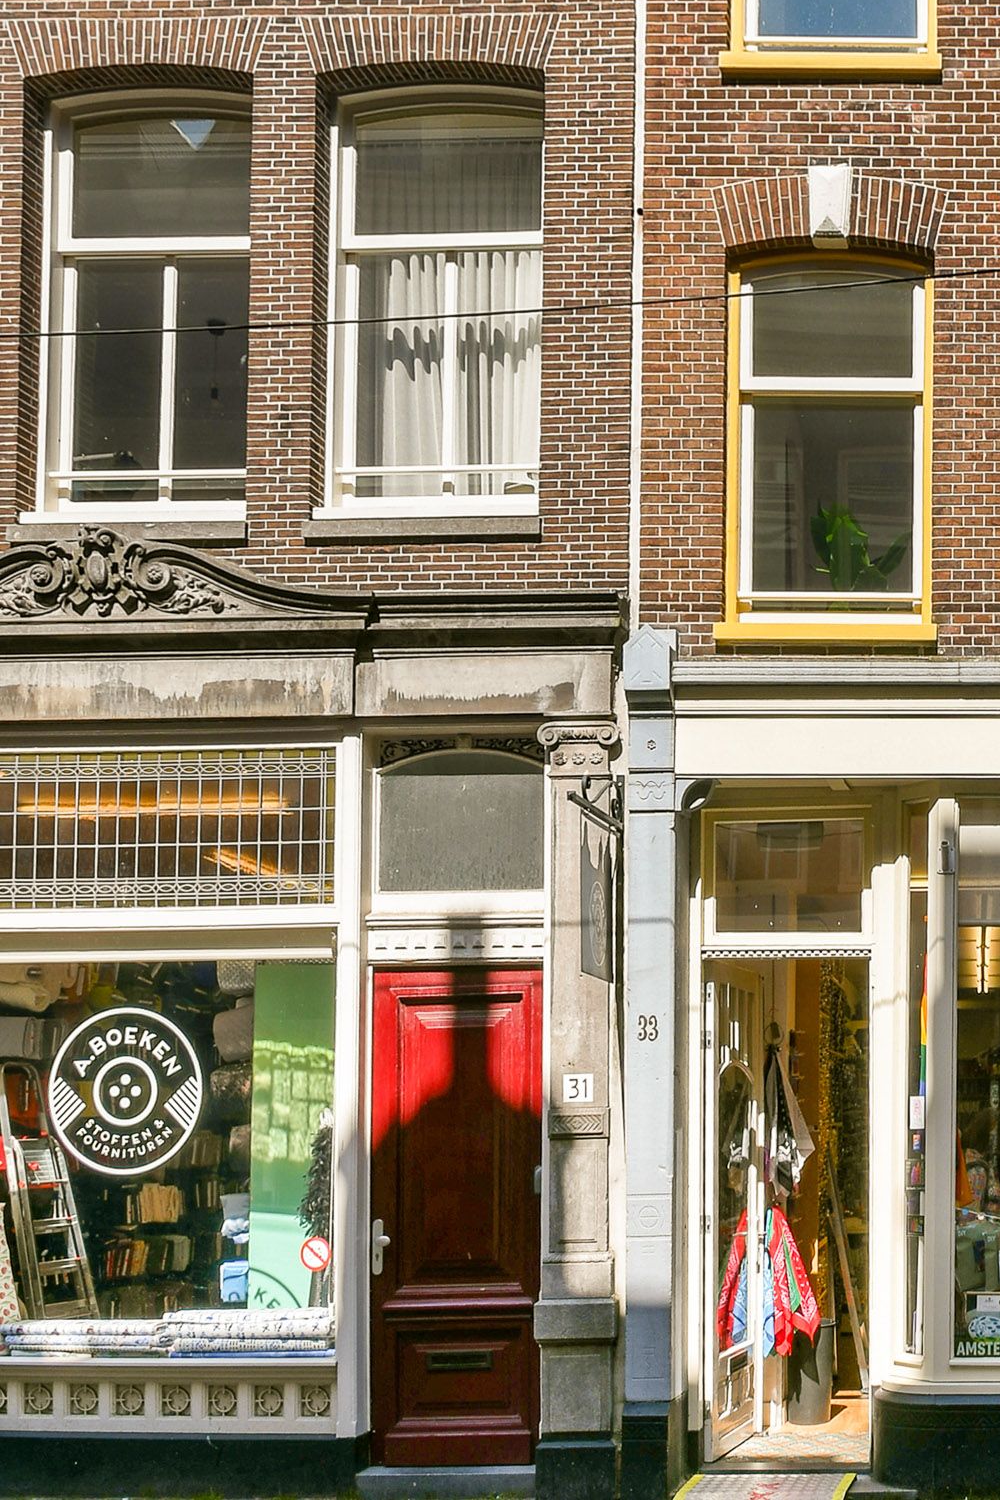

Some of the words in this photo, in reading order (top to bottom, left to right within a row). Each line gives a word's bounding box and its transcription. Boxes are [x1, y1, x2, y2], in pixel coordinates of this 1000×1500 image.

[637, 1014, 658, 1041] 33
[568, 1078, 588, 1099] 31
[76, 1127, 173, 1158] FOURNITUREN
[85, 1118, 153, 1146] STOFFEN
[153, 1119, 164, 1130] &
